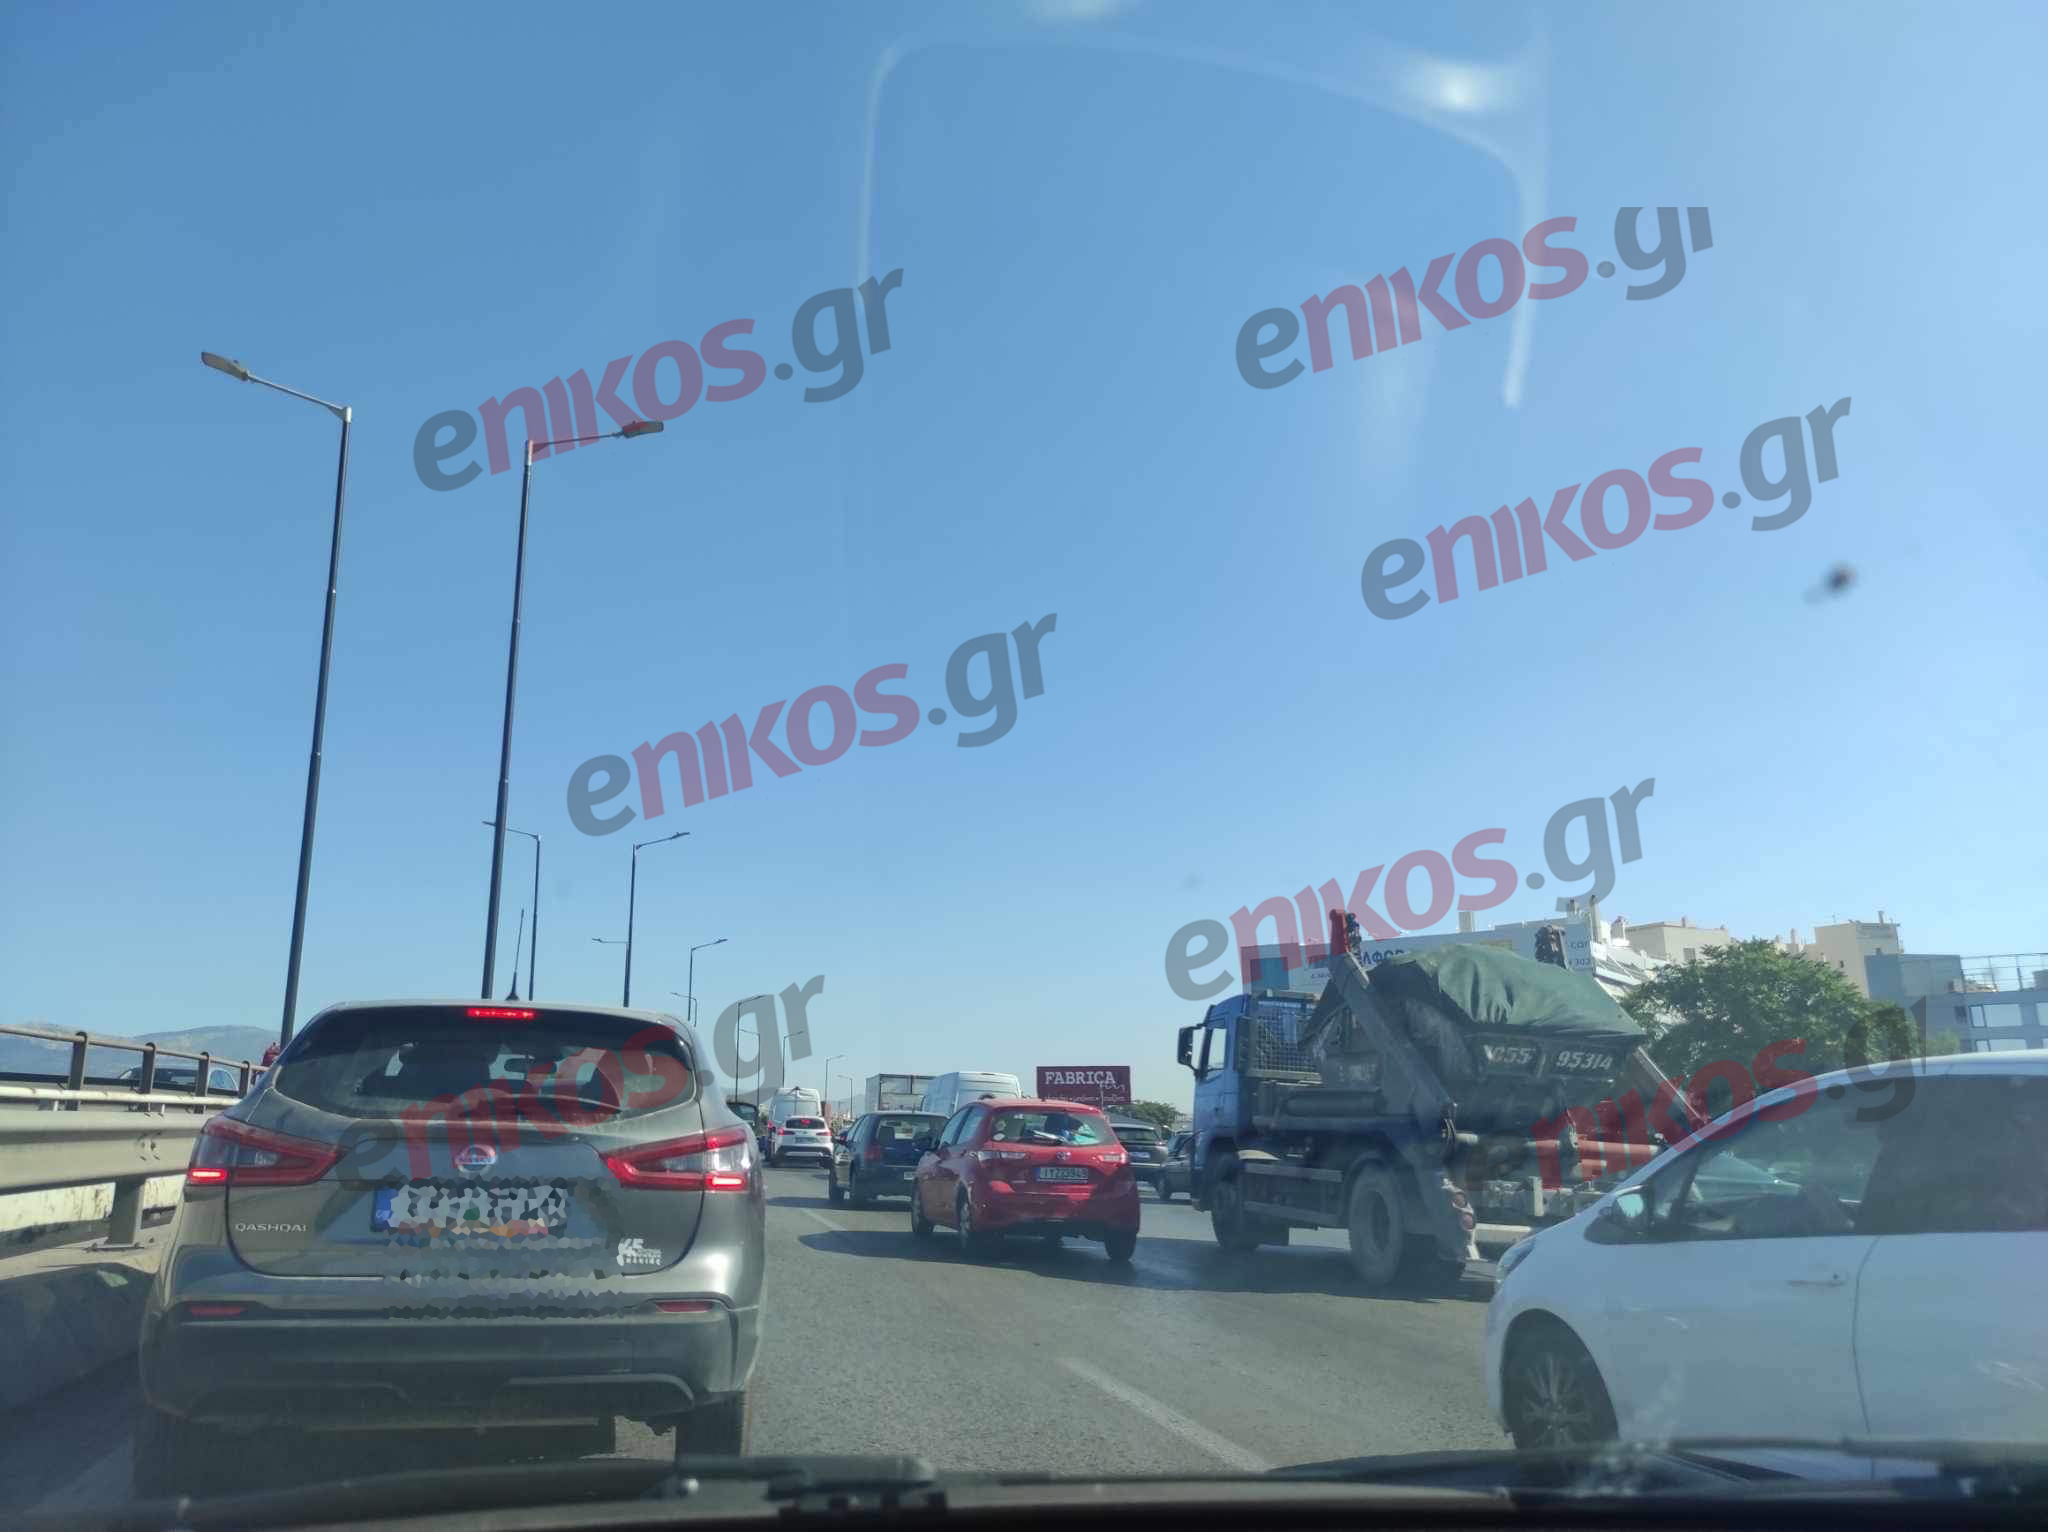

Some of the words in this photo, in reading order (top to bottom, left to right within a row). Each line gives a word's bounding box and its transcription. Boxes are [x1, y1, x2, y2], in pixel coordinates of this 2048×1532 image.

[1556, 1051, 1613, 1070] 95314
[1044, 1071, 1116, 1085] FABRICA
[235, 1222, 307, 1233] QASHQAI
